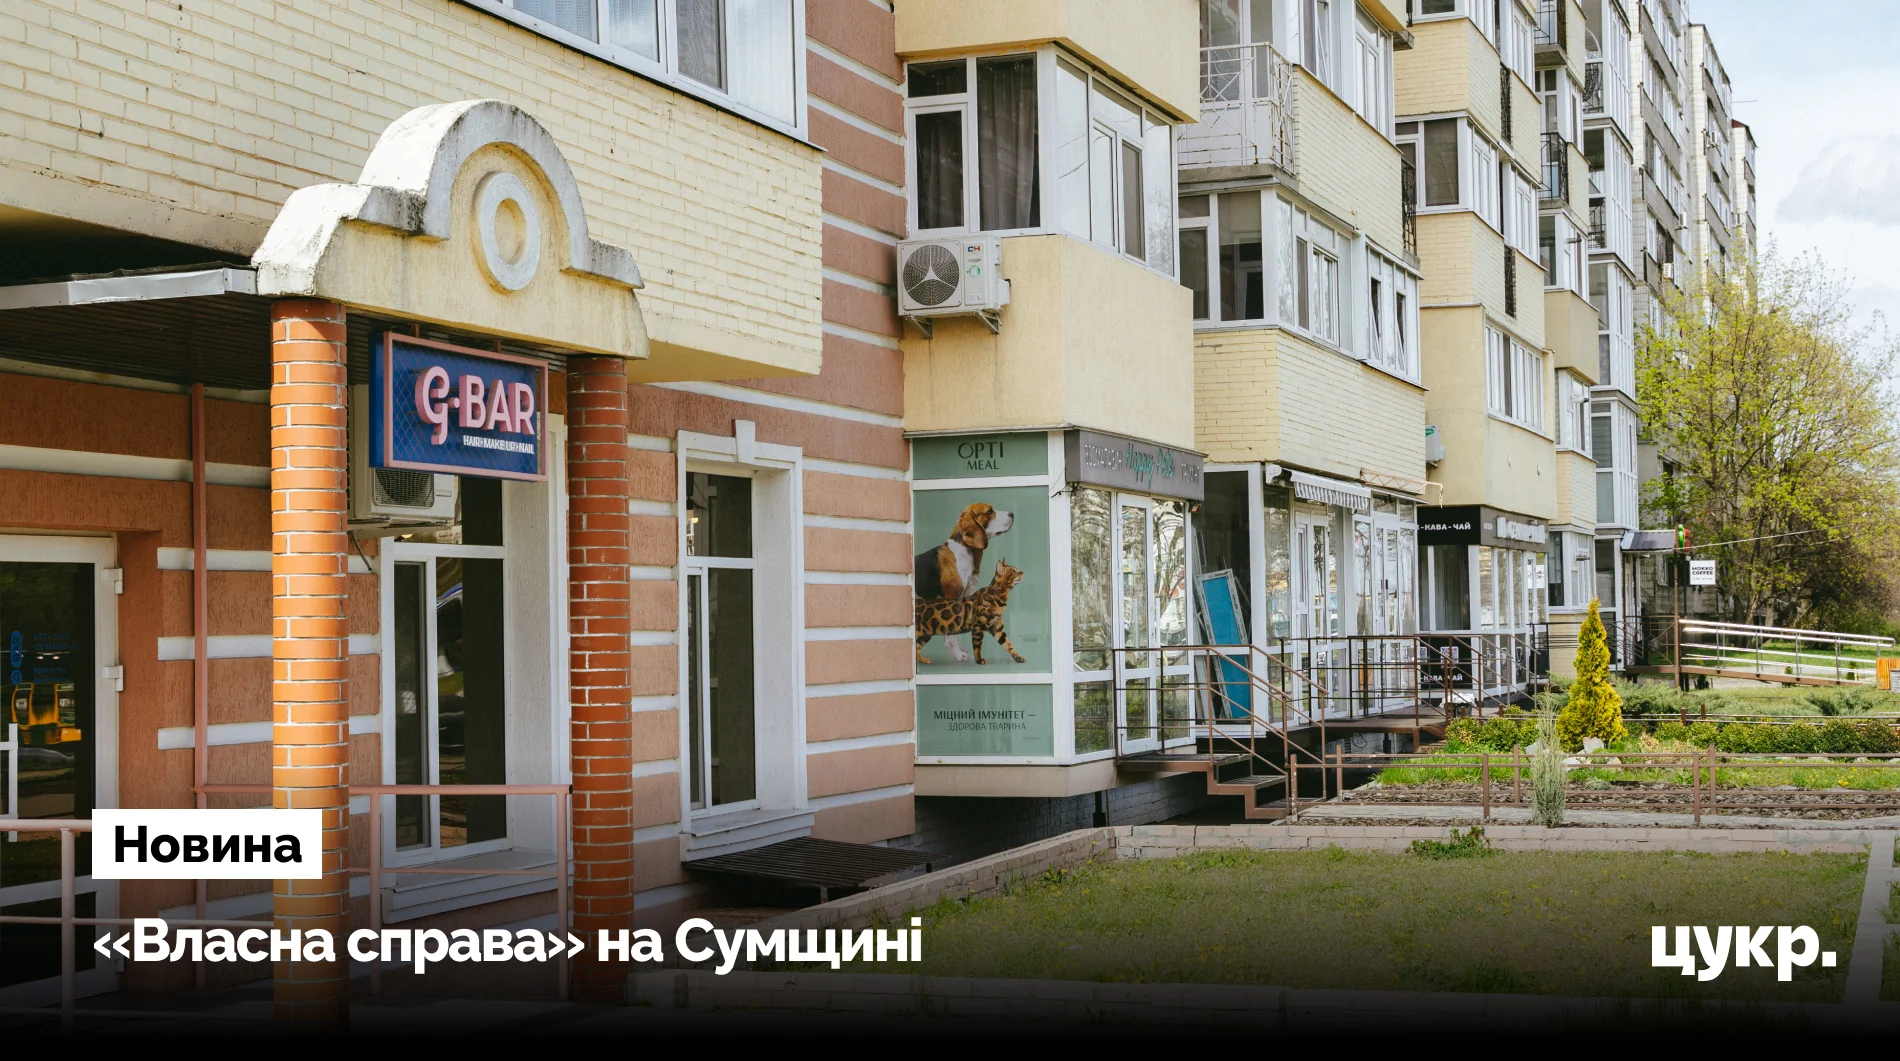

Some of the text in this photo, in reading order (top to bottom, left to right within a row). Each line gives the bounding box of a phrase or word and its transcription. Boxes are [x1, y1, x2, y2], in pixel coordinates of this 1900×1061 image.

[463, 435, 480, 448] HAIR
[518, 443, 535, 455] NAIL
[957, 441, 1004, 459] OPTI
[966, 459, 1000, 471] MEAL
[1125, 442, 1175, 489] Happy Pets
[933, 708, 976, 721] МІЦНИЙ
[978, 710, 1025, 720] ІМУНІТЕТ
[947, 722, 1027, 732] ЗДОРОВА ТВАРИНА
